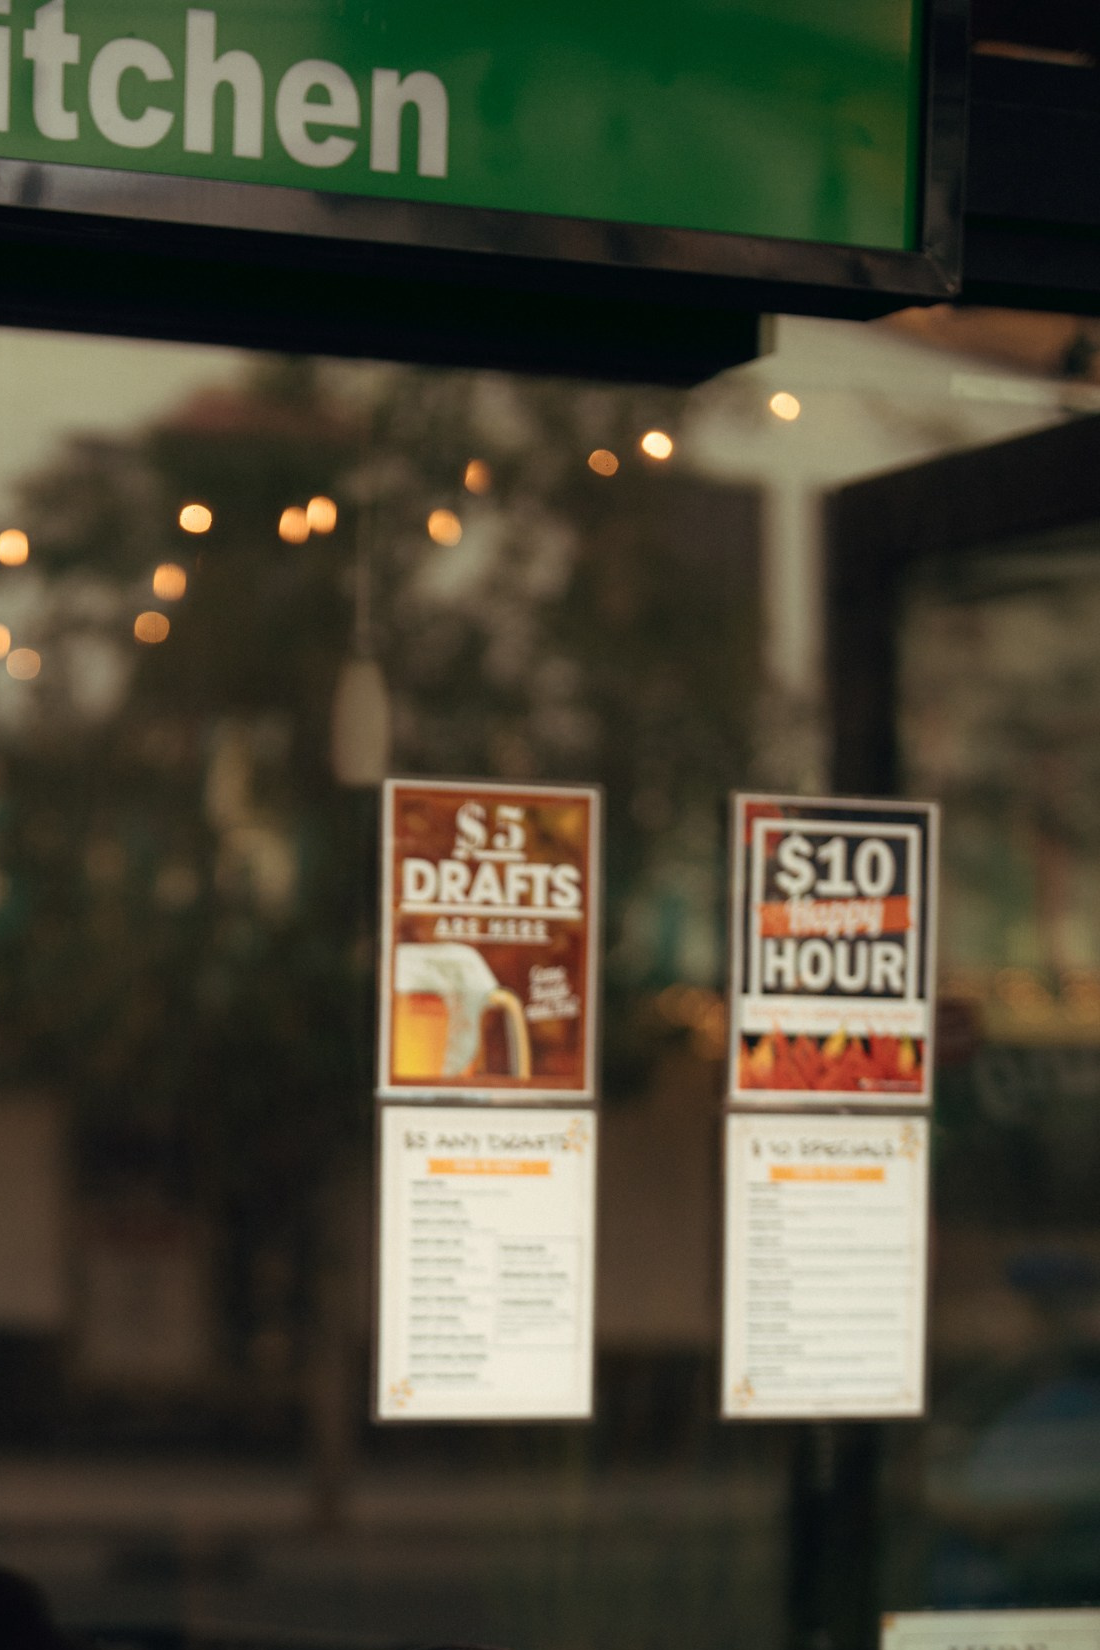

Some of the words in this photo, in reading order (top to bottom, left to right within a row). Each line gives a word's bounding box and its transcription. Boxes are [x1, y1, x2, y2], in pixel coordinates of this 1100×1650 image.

[402, 857, 582, 909] DRAFTS
[774, 832, 896, 899] $10
[763, 938, 905, 993] HOUR
